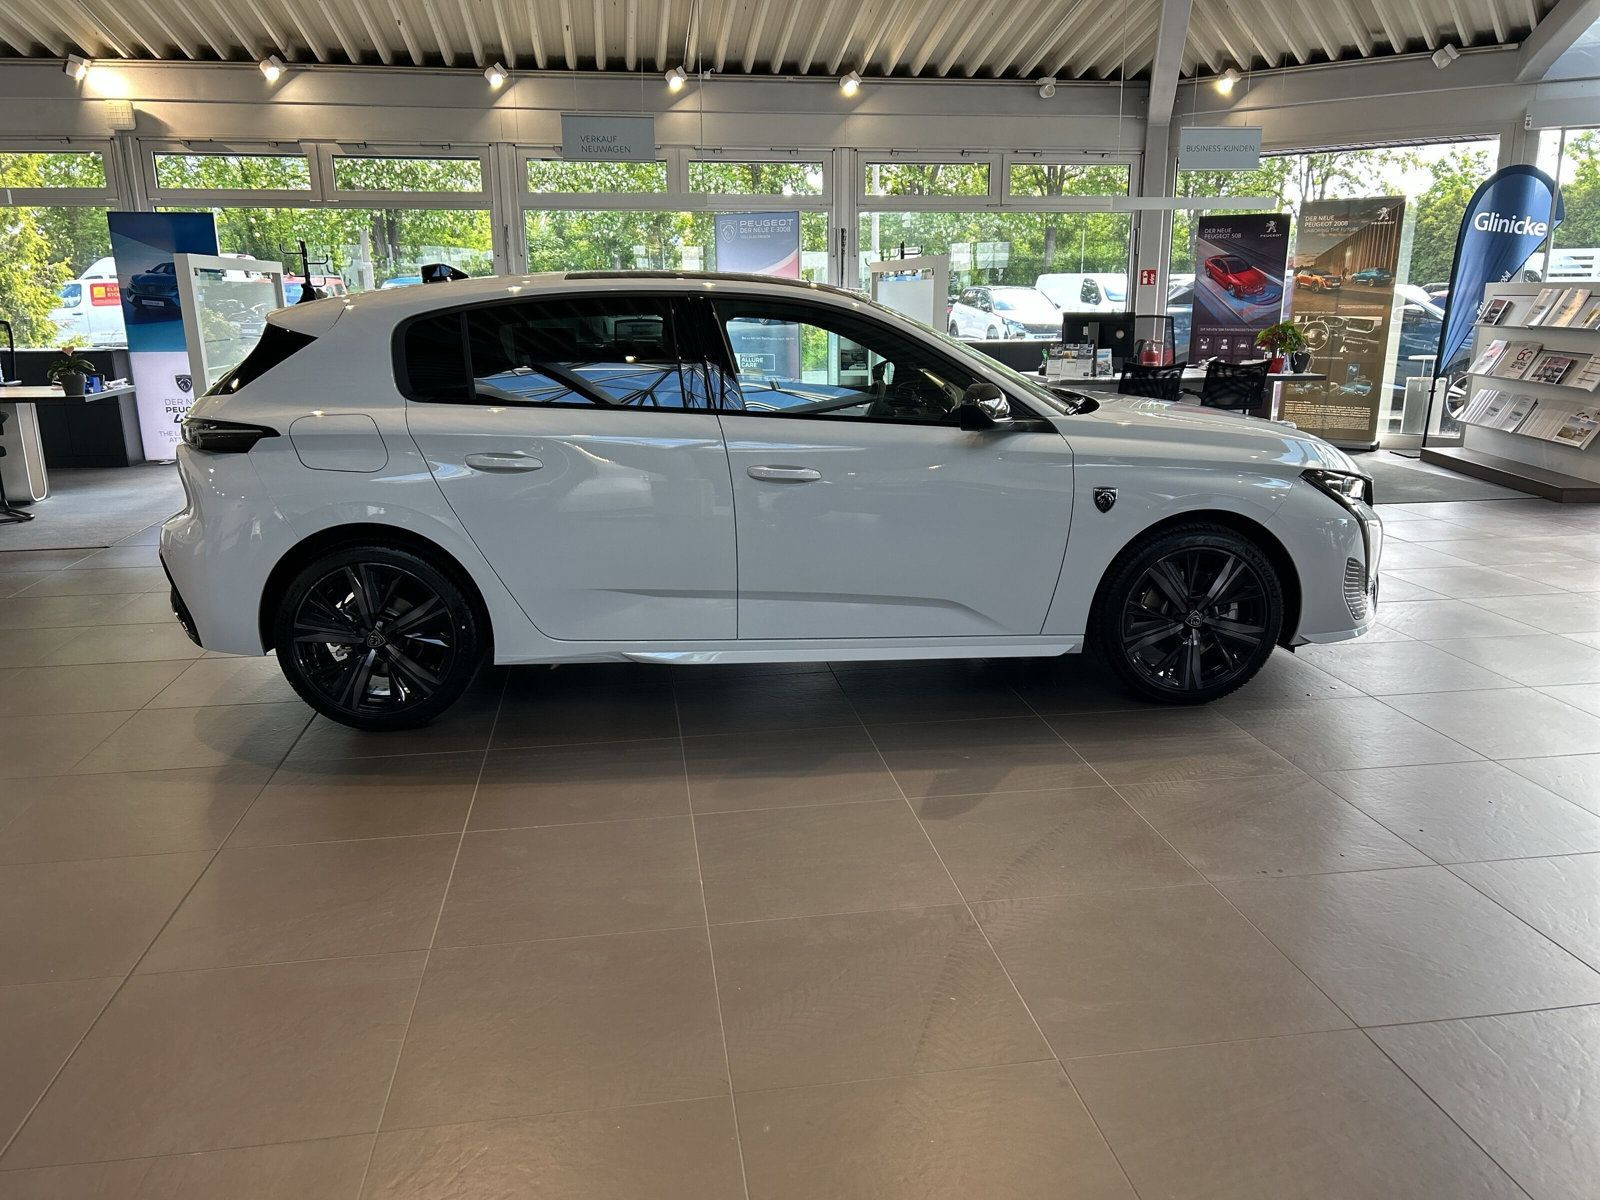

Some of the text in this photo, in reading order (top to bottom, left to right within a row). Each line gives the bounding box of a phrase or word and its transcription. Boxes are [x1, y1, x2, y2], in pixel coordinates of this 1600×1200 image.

[580, 135, 617, 143] VERKAUF
[581, 145, 631, 153] NEUWAGEN
[1186, 144, 1255, 153] BUSINESS-KUNDEN
[740, 219, 793, 227] PEUGEOT
[1474, 211, 1547, 237] Glinicke
[164, 398, 184, 406] DER
